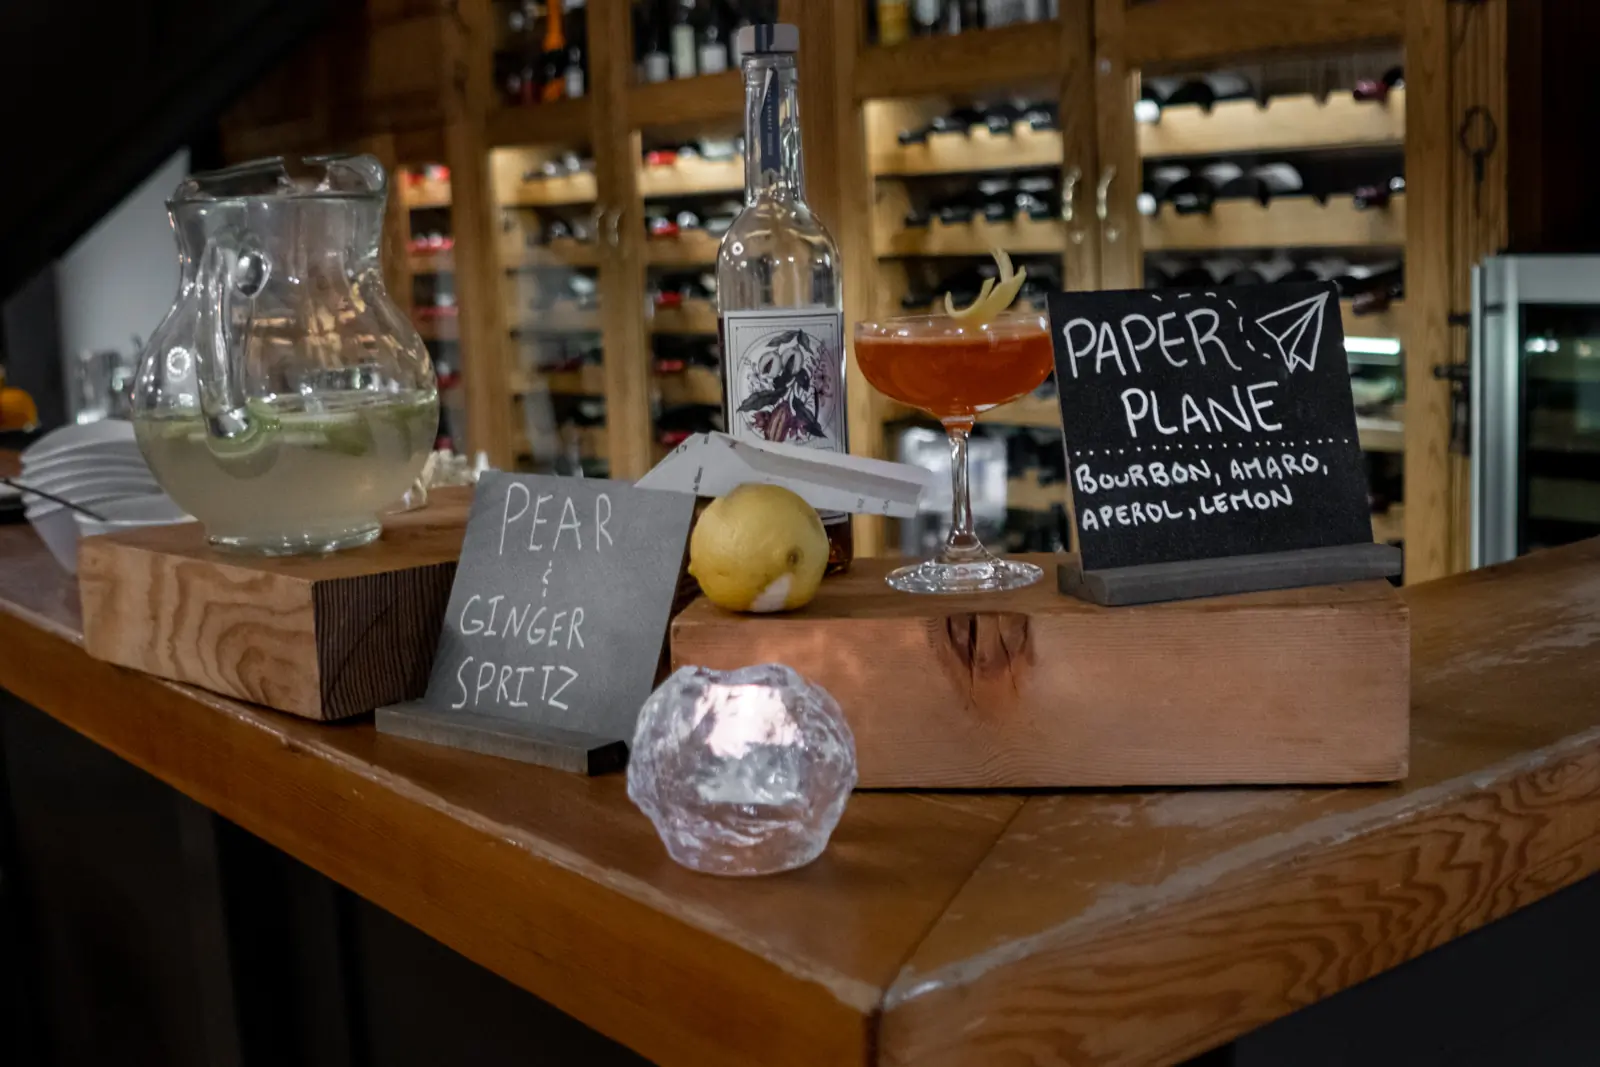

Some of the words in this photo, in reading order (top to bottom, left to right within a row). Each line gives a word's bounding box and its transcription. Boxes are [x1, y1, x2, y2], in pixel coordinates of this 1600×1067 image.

[1063, 308, 1242, 378] PAPER
[1120, 381, 1283, 438] PLANE
[1076, 458, 1221, 494] BOURBON,
[1230, 453, 1329, 481] AMARO,
[499, 482, 613, 556] PEAR
[460, 595, 585, 650] GINGER
[452, 656, 579, 711] SPRITZ
